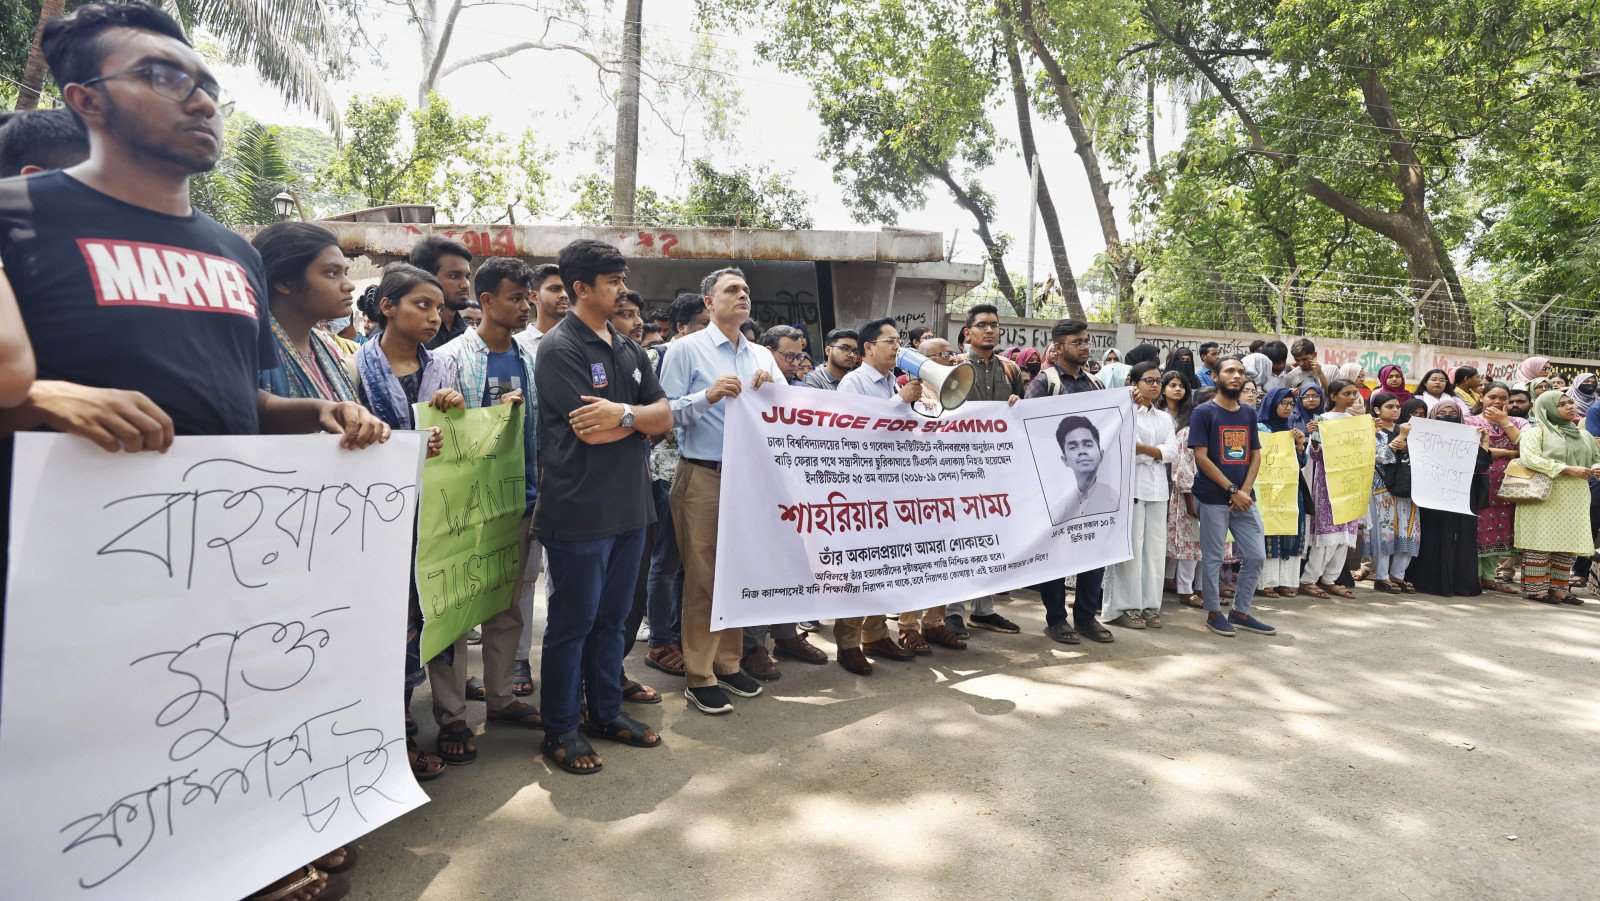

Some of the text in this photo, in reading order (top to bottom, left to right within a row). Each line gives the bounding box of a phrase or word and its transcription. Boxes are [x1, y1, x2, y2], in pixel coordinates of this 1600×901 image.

[762, 406, 1008, 432] JUSTICE FOR SHAMMO
[767, 436, 784, 448] ঢাকা
[787, 434, 840, 450] বিশ্ববিদ্যালয়ের
[842, 438, 860, 450] শিক্ষা
[862, 442, 868, 450] ও
[870, 442, 894, 451] গবেষণা
[971, 441, 994, 453] অনুষ্ঠান
[996, 441, 1014, 450] শেষে
[774, 452, 1012, 470] বাড়ি ফেরার পথে সন্ত্রাসীদের ছুরিকাঘাতে টিএসসি এলাকায় নিহত হয়েছেন
[852, 474, 862, 484] ২৫
[864, 474, 876, 483] তম
[878, 473, 900, 482] ব্যাচের
[938, 472, 960, 482] সেশন)
[960, 468, 986, 480] শিক্ষার্থী
[440, 476, 524, 536] WANT
[778, 491, 1012, 536] শাহরিয়ার আলম সাম্য
[819, 546, 842, 566] তাঁর
[846, 543, 912, 563] অকালপ্রয়াণে
[914, 540, 946, 554] আমরা
[428, 540, 520, 619] JUSTICE
[814, 570, 848, 581] অবিলম্বে
[850, 569, 862, 580] তাঁর
[864, 564, 901, 578] হত্যাকারীদের
[970, 554, 988, 564] করতে
[742, 588, 759, 600] নিজ
[762, 584, 804, 598] ক্যাম্পাসেই
[806, 584, 820, 594] যদি
[822, 583, 860, 594] শিক্ষার্থীরা
[862, 582, 885, 592] নিরাপদ
[886, 580, 894, 588] না
[976, 567, 988, 576] এই
